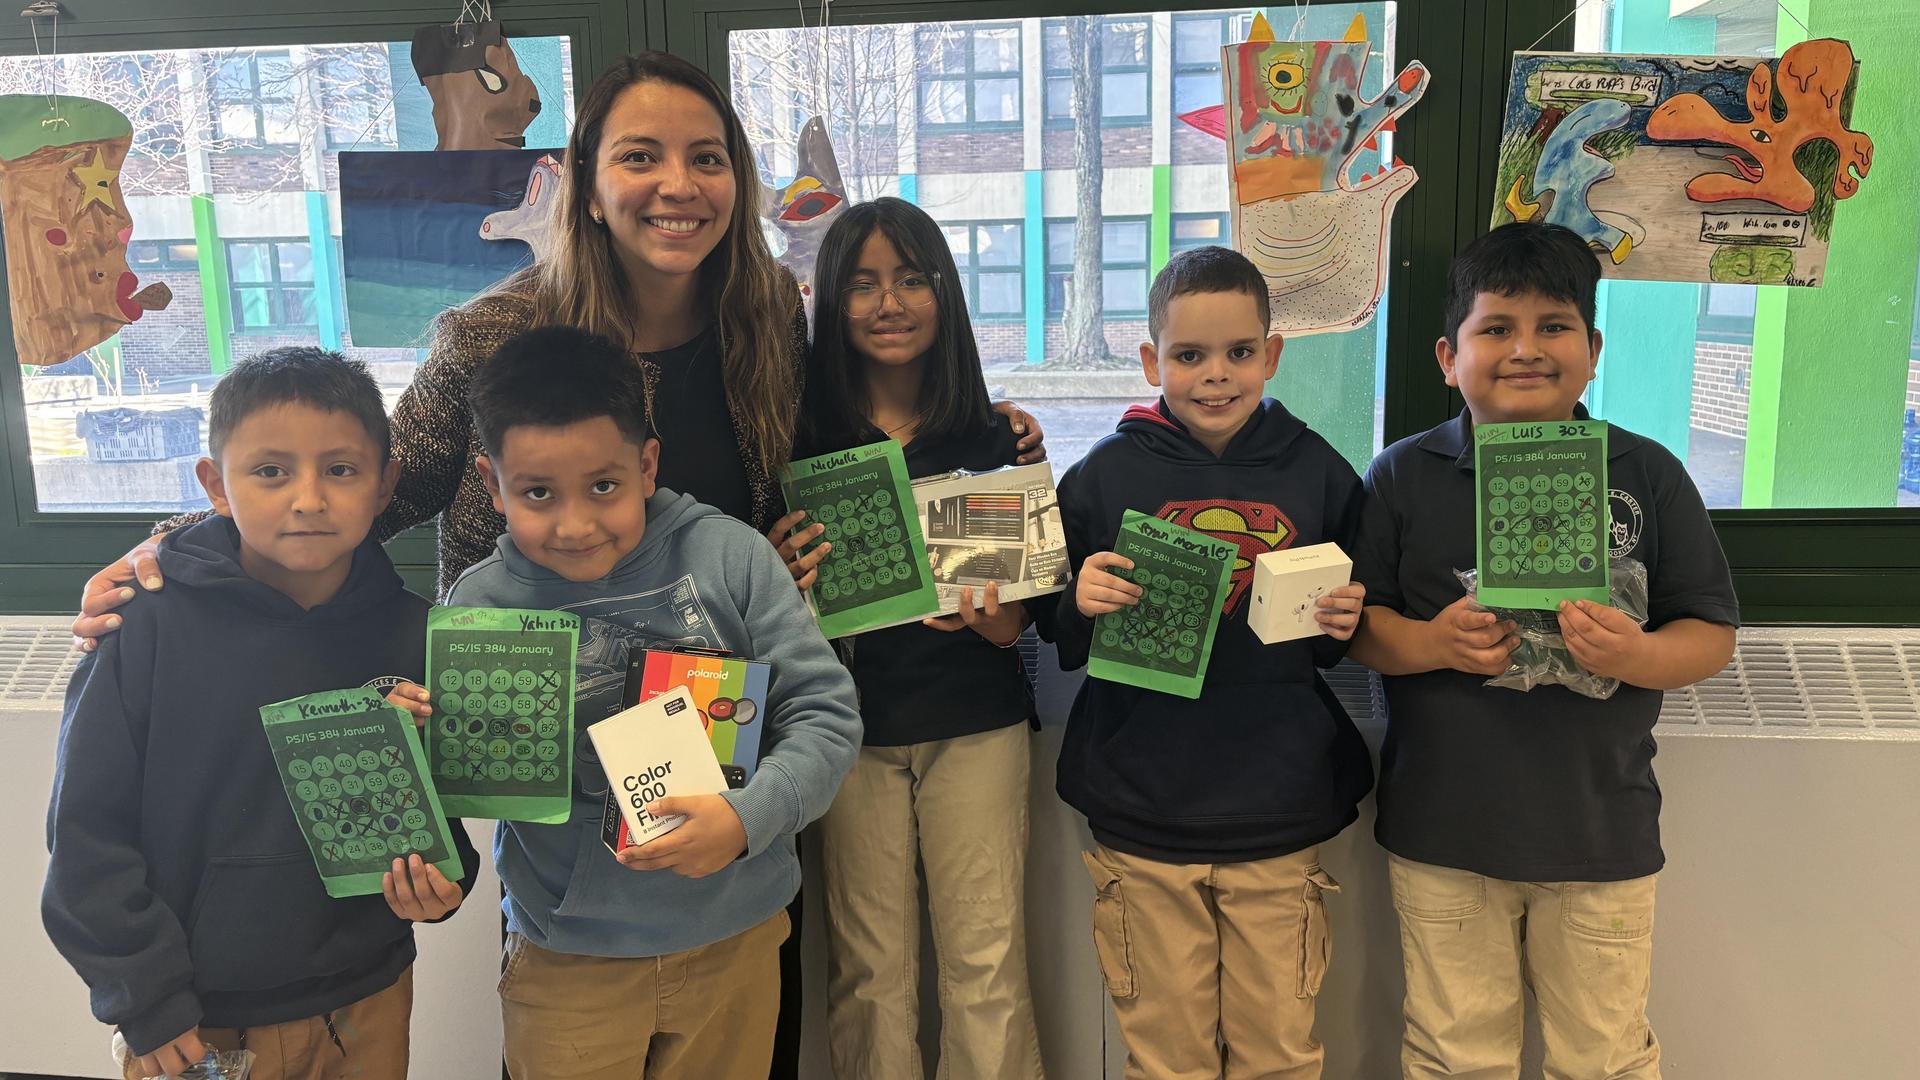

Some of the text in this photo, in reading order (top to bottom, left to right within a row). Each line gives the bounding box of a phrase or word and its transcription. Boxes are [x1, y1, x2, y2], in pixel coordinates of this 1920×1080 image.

[1631, 76, 1658, 92] Bird
[1559, 425, 1592, 437] 302
[864, 446, 882, 457] WIN
[1495, 451, 1586, 463] PS/IS 384 January
[800, 471, 878, 496] PS/IS 384 January
[1515, 481, 1524, 489] 18
[1536, 480, 1546, 488] 41
[1557, 479, 1568, 487] 59
[1029, 487, 1047, 499] 32
[823, 509, 833, 518] 20
[840, 503, 852, 513] 35
[1515, 501, 1526, 509] 30
[1536, 500, 1547, 508] 43
[1557, 499, 1568, 507] 58
[828, 526, 838, 535] 18
[846, 521, 856, 530] 41
[1173, 537, 1233, 561] Morales
[1536, 540, 1549, 549] 44
[838, 564, 848, 572] 30
[874, 553, 884, 562] 49
[892, 548, 902, 558] 72
[1128, 543, 1207, 576] PS/IS 384 January
[1538, 560, 1548, 568] 31
[826, 587, 835, 596] 13
[843, 582, 852, 590] 27
[879, 571, 889, 580] 59
[520, 615, 556, 636] Yahir
[560, 618, 578, 629] 302
[1183, 634, 1193, 642] 65
[450, 643, 553, 656] PS/IS 384 January
[1105, 634, 1115, 642] 10
[1180, 650, 1189, 659] 71
[447, 676, 456, 685] 12
[472, 676, 481, 685] 18
[495, 677, 505, 685] 41
[519, 677, 531, 685] 59
[687, 668, 729, 680] polaroid
[469, 700, 482, 708] 30
[493, 700, 506, 709] 43
[518, 700, 530, 709] 58
[285, 724, 386, 745] PS/IS 384 January
[492, 746, 505, 754] 44
[543, 746, 553, 754] 72
[295, 765, 306, 773] 15
[318, 762, 328, 771] 21
[339, 759, 352, 768] 40
[362, 756, 375, 765] 53
[495, 767, 505, 775] 31
[518, 767, 530, 775] 52
[326, 784, 336, 792] 26
[348, 781, 358, 789] 31
[369, 778, 382, 786] 59
[393, 773, 406, 782] 62
[623, 760, 672, 792] Color
[630, 782, 666, 809] 600
[408, 814, 421, 824] 65
[348, 845, 360, 853] 24
[415, 836, 427, 845] 71
